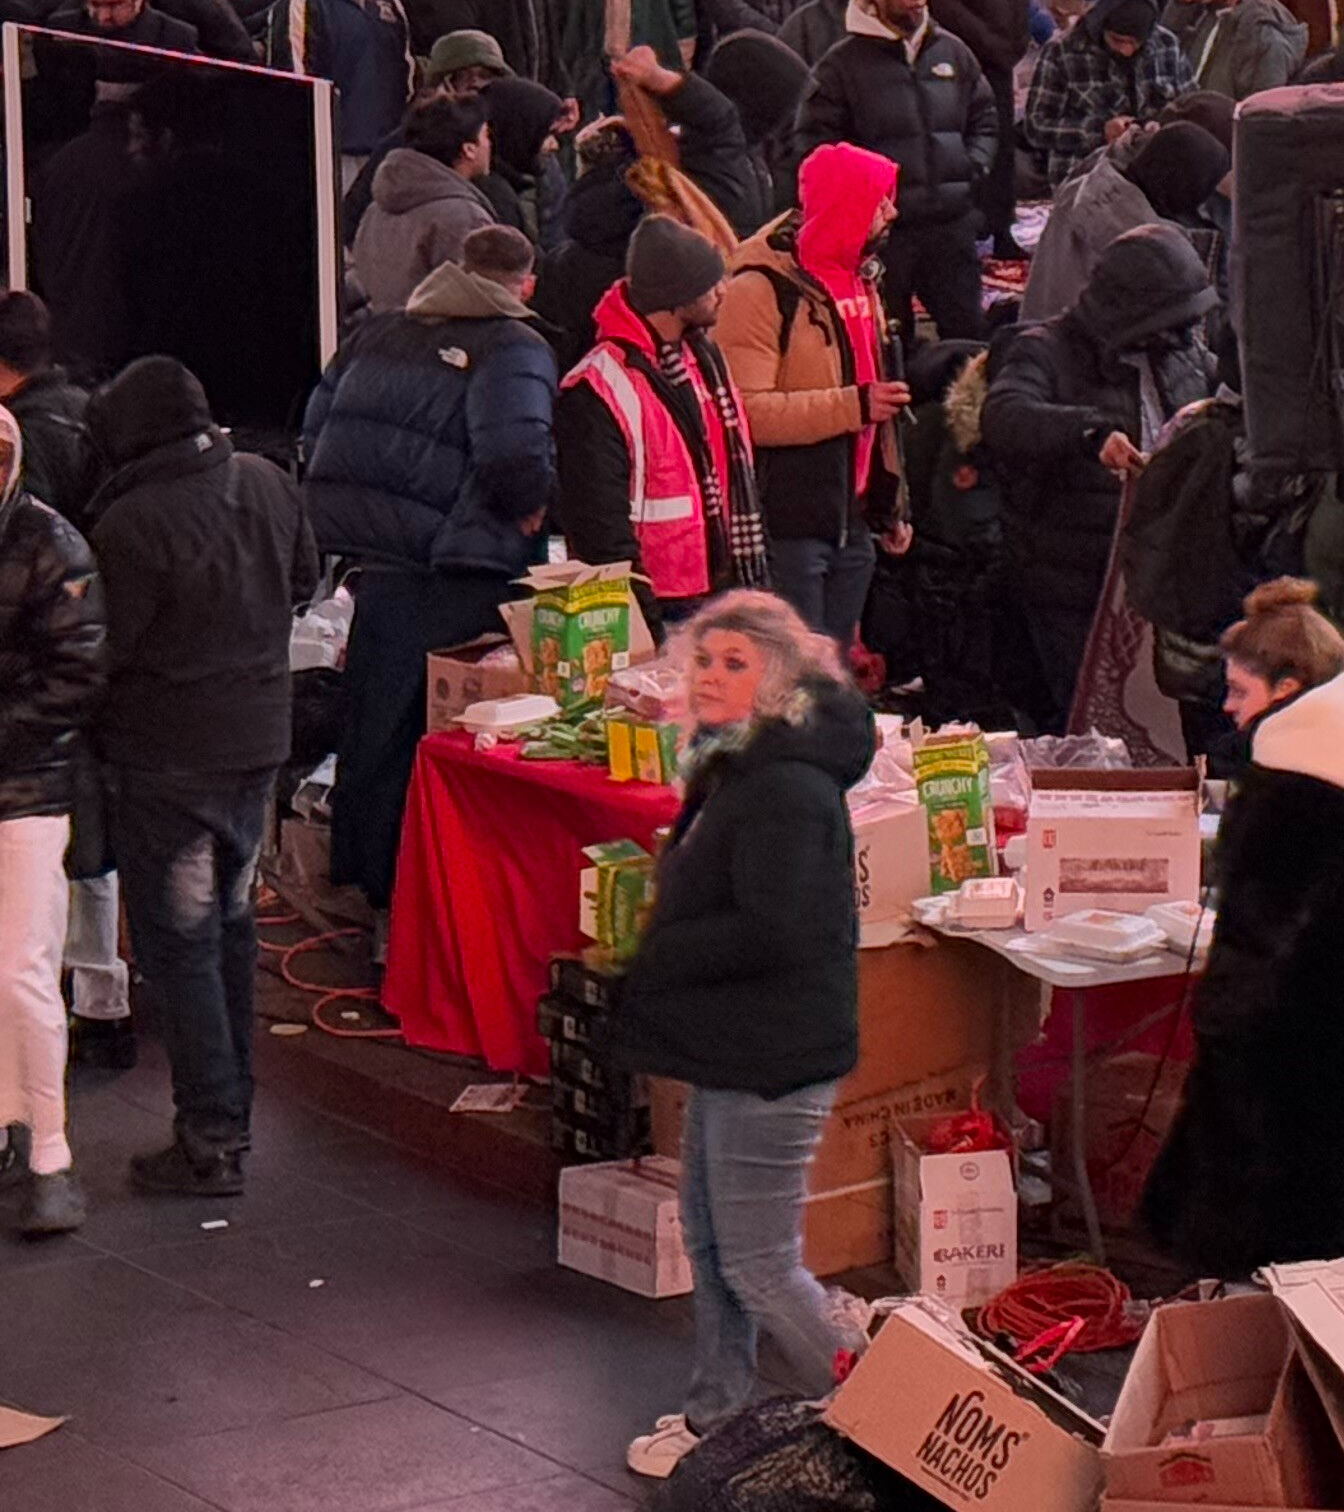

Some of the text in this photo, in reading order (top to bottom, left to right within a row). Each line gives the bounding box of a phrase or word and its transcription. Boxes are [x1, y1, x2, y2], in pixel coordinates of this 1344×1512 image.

[922, 775, 973, 799] CRUNCHY
[894, 1101, 911, 1116] IN
[913, 1089, 957, 1113] MADE
[934, 1390, 1021, 1471] NOMS
[915, 1431, 998, 1501] NACHOS
